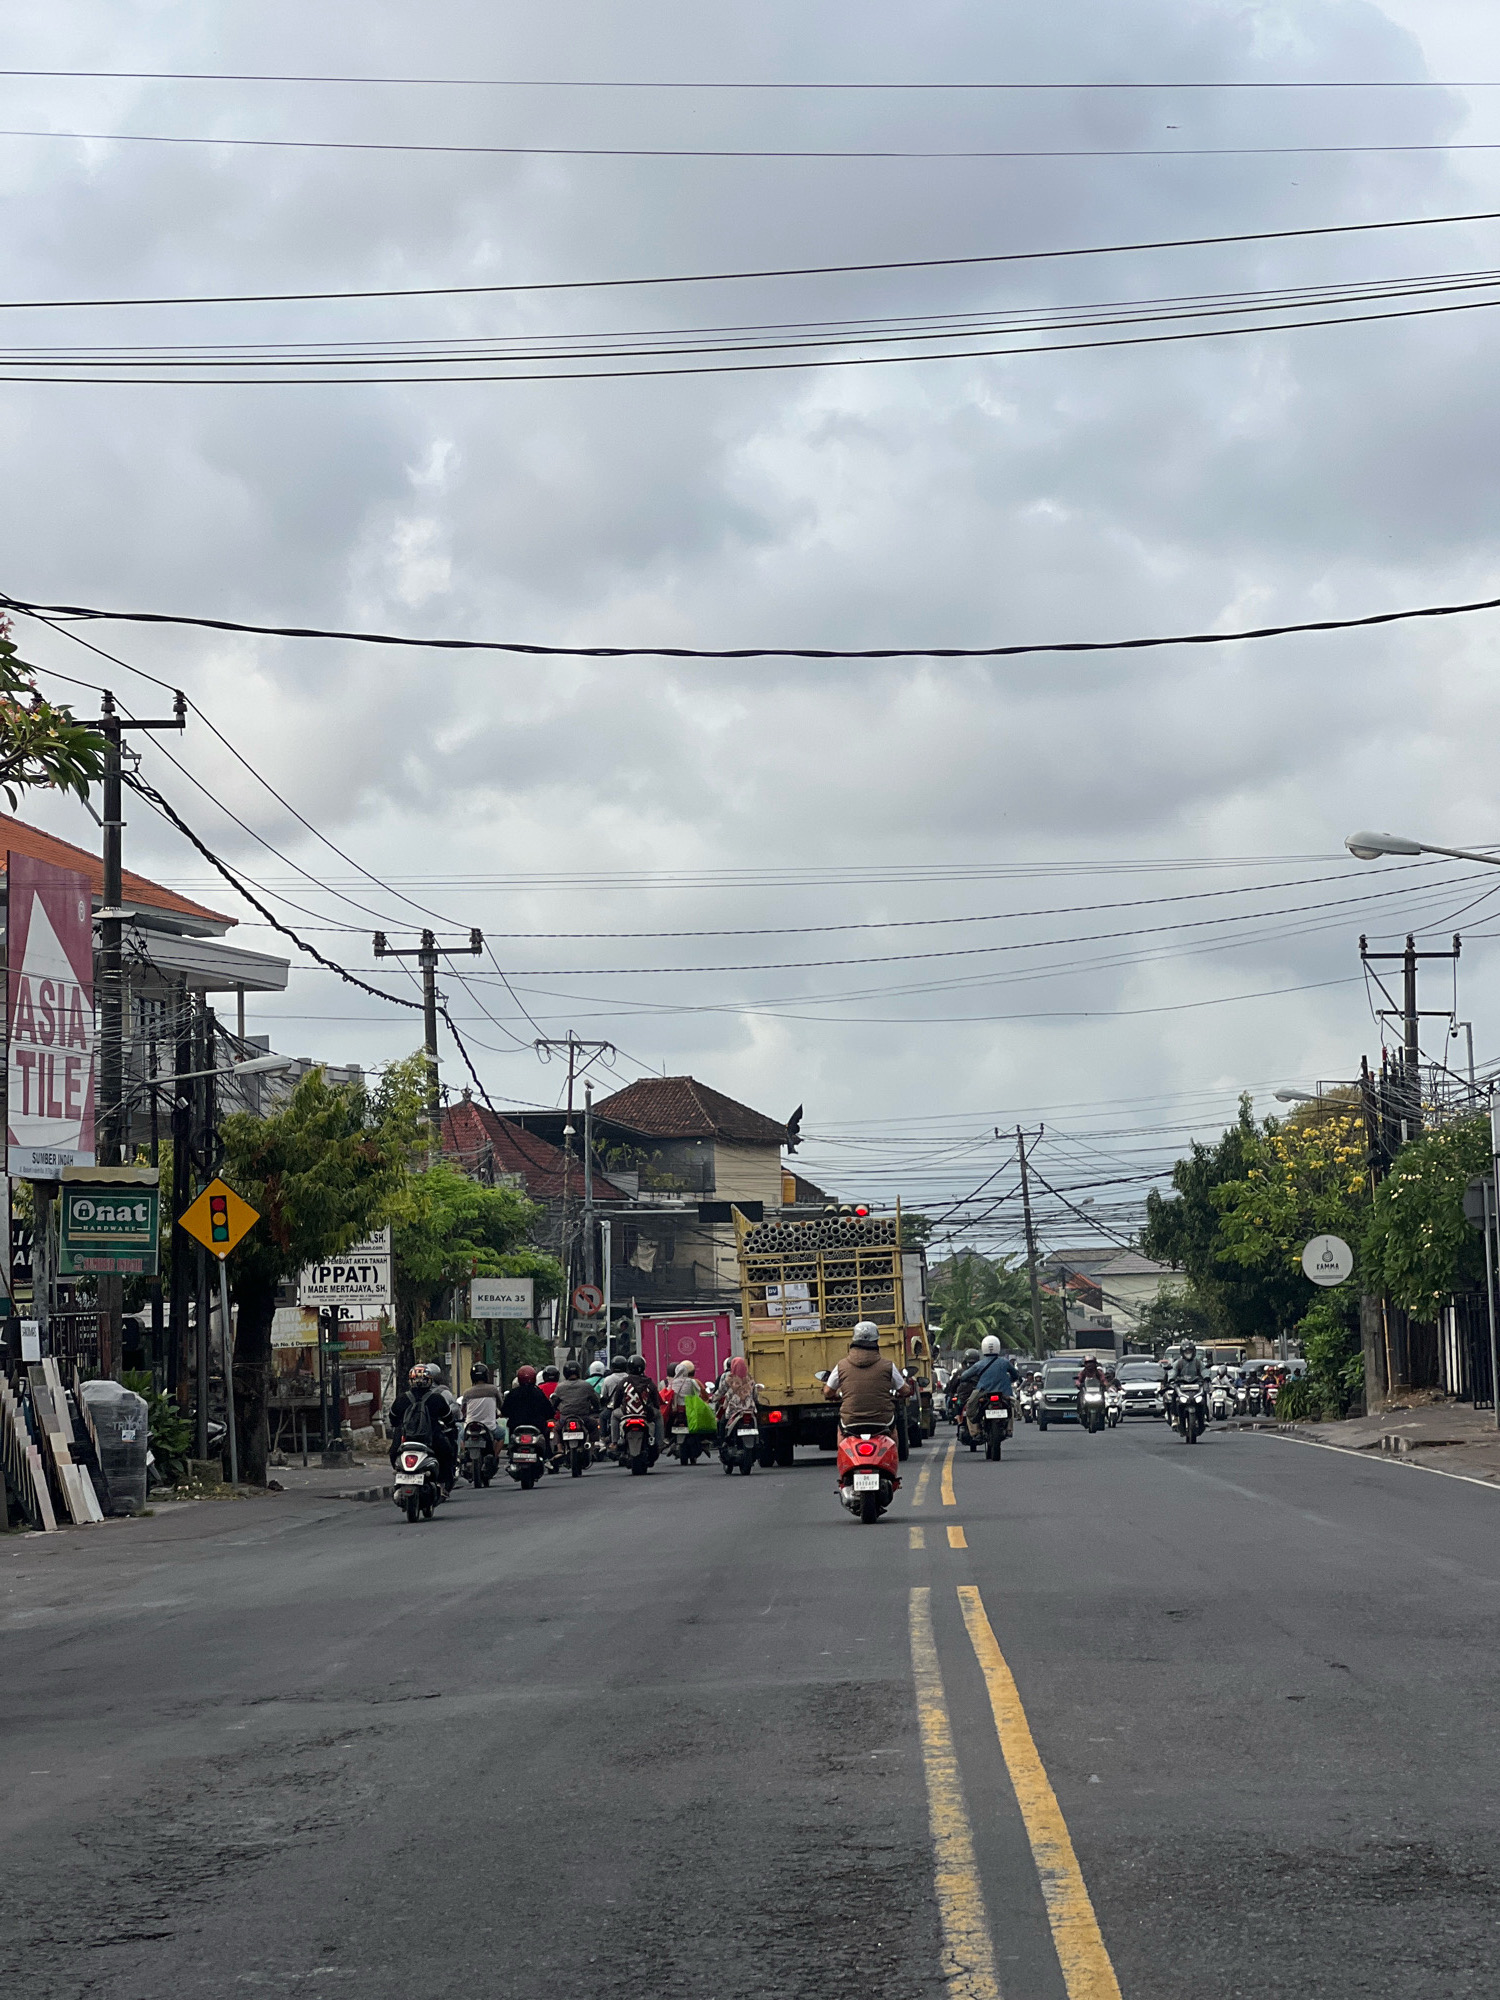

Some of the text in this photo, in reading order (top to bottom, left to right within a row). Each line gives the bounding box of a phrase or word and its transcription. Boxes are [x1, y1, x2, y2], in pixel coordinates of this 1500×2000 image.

[15, 976, 87, 1050] ASIA
[16, 1050, 82, 1121] TILE
[32, 1152, 74, 1166] SUMBER INDAH
[73, 1200, 148, 1222] Onat
[312, 1265, 379, 1284] (PPAT)
[307, 1285, 329, 1293] MADE
[329, 1284, 374, 1294] MERTAJAYA,
[375, 1284, 388, 1293] SH.
[477, 1294, 526, 1302] KEBAYA 35
[349, 1322, 379, 1332] STAMPER
